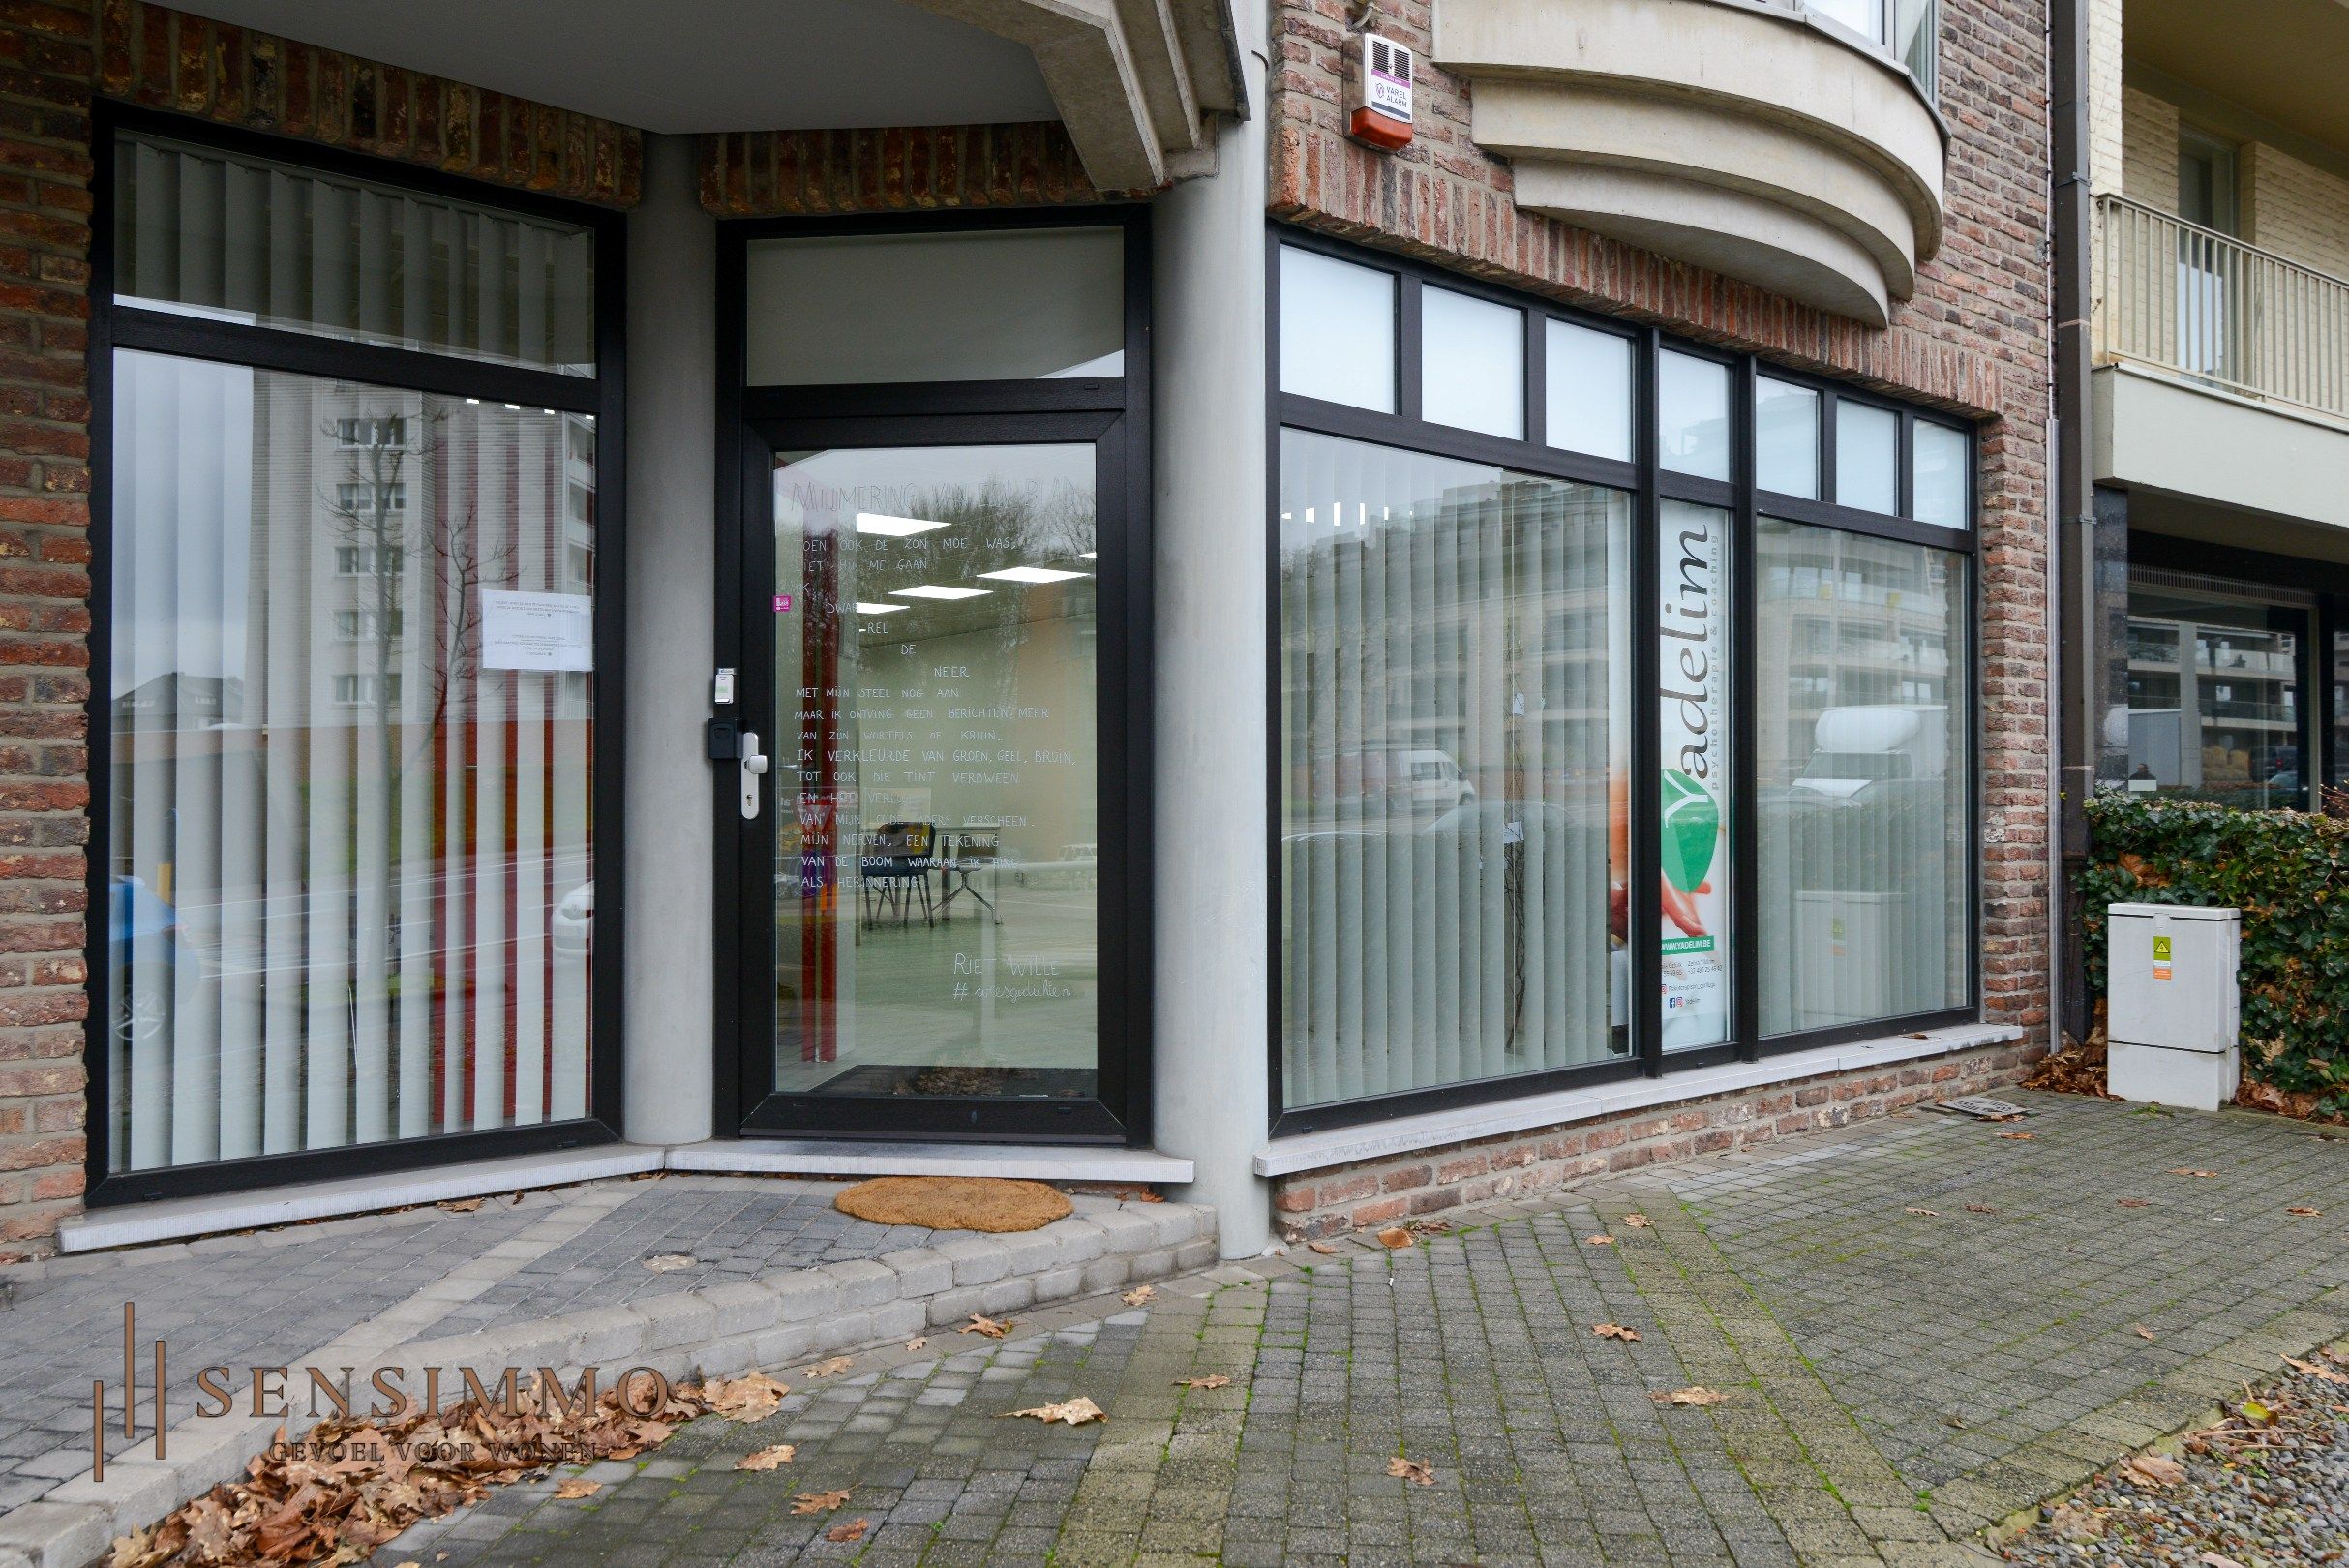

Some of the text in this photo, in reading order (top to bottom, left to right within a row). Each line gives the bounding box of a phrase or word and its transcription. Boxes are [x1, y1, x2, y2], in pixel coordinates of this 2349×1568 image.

[1386, 85, 1407, 100] VAREL
[1386, 95, 1407, 108] ALARM
[839, 539, 863, 551] OOK
[875, 540, 889, 551] DE
[904, 538, 928, 550] ZON
[943, 538, 968, 549] MOE
[897, 558, 927, 570] GAAN
[867, 622, 888, 634] REL
[901, 645, 916, 655] DE
[1710, 534, 1720, 791] psychotherapie & coaching
[934, 667, 970, 678] NEER
[796, 687, 818, 698] MET
[858, 687, 889, 698] STEEL
[902, 688, 923, 698] NOG
[937, 687, 959, 698] AAN
[794, 709, 824, 719] MAAR
[850, 709, 892, 719] ONTVING
[906, 709, 933, 719] GEEN
[797, 731, 817, 740] VAN
[864, 731, 913, 740] WORTELS
[930, 731, 942, 740] OF
[797, 749, 813, 761] IK
[828, 750, 910, 762] VERKLEURDE
[922, 750, 944, 762] VAN
[797, 770, 819, 782] TOT
[833, 770, 856, 782] OOK
[873, 770, 891, 782] DIE
[904, 770, 936, 782] TINT
[799, 813, 822, 825] VAN
[800, 833, 828, 845] MIJN
[906, 834, 928, 847] EEN
[941, 834, 1000, 847] TEKENING
[801, 856, 825, 867] VAN
[836, 857, 848, 867] DE
[861, 857, 892, 867] BOOM
[908, 857, 957, 867] WAARAAN
[801, 876, 823, 888] ALS
